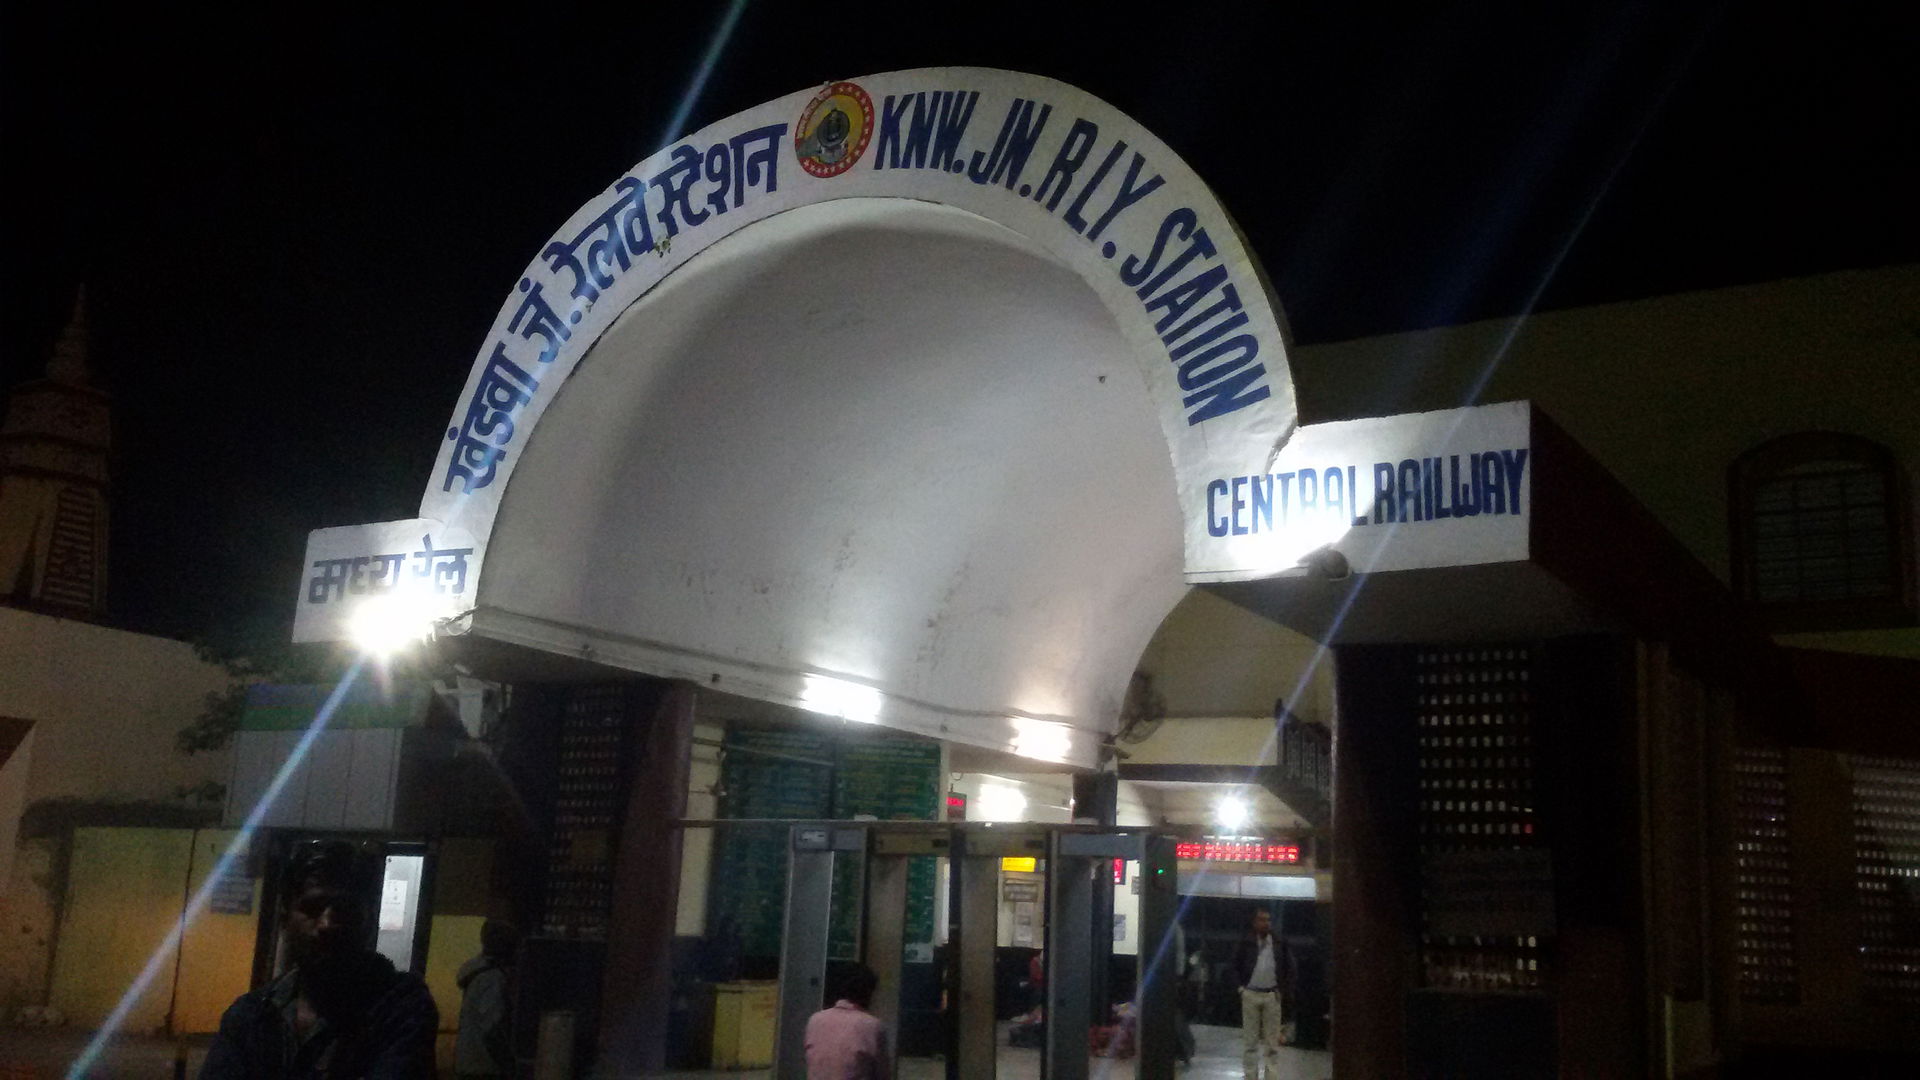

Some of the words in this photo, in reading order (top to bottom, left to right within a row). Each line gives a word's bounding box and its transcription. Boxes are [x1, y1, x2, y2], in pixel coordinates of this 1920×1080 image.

[442, 341, 539, 496] खंडवा
[648, 122, 788, 238] स्टेशन
[874, 90, 980, 174] KNW.
[973, 98, 1052, 197] JN.
[1033, 117, 1166, 259] RLY.
[1120, 207, 1271, 426] STATION
[1206, 464, 1368, 537] CENTRAL
[1373, 448, 1529, 525] RAILWAY
